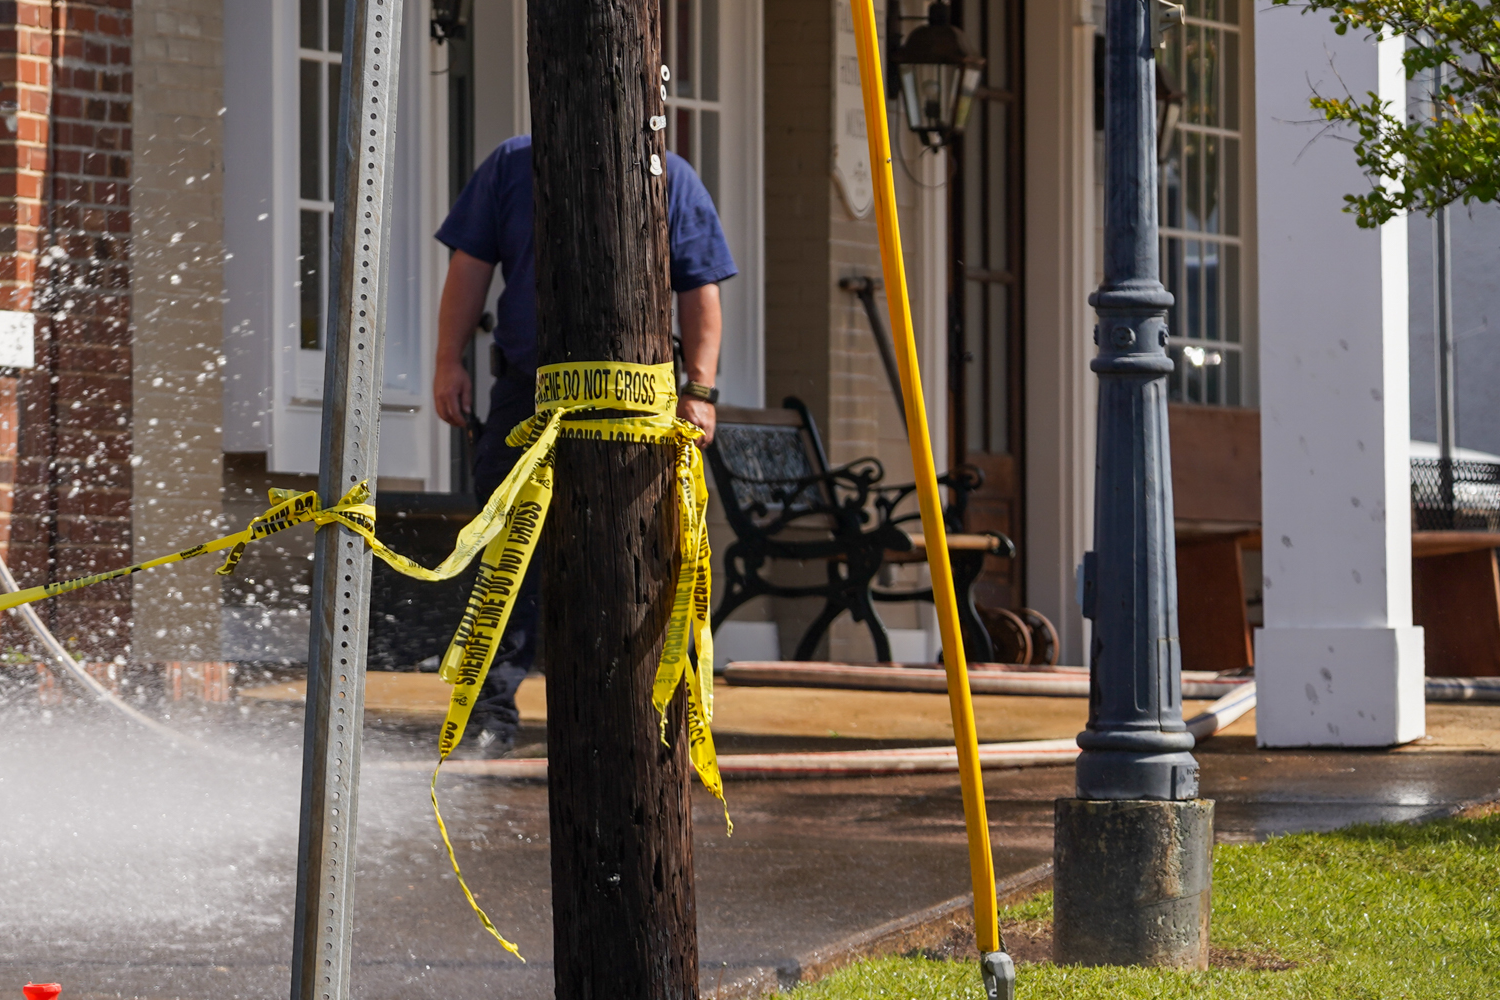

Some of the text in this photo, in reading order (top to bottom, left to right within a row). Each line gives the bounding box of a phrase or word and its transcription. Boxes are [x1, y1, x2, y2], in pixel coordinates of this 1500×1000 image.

[563, 369, 580, 401] DO
[584, 368, 611, 400] NOT
[614, 369, 656, 406] CROSS
[506, 500, 543, 546] CROSS
[497, 546, 525, 575] NOT
[488, 573, 514, 596] DO
[476, 598, 506, 629] LINE
[455, 631, 494, 686] SHERIFF
